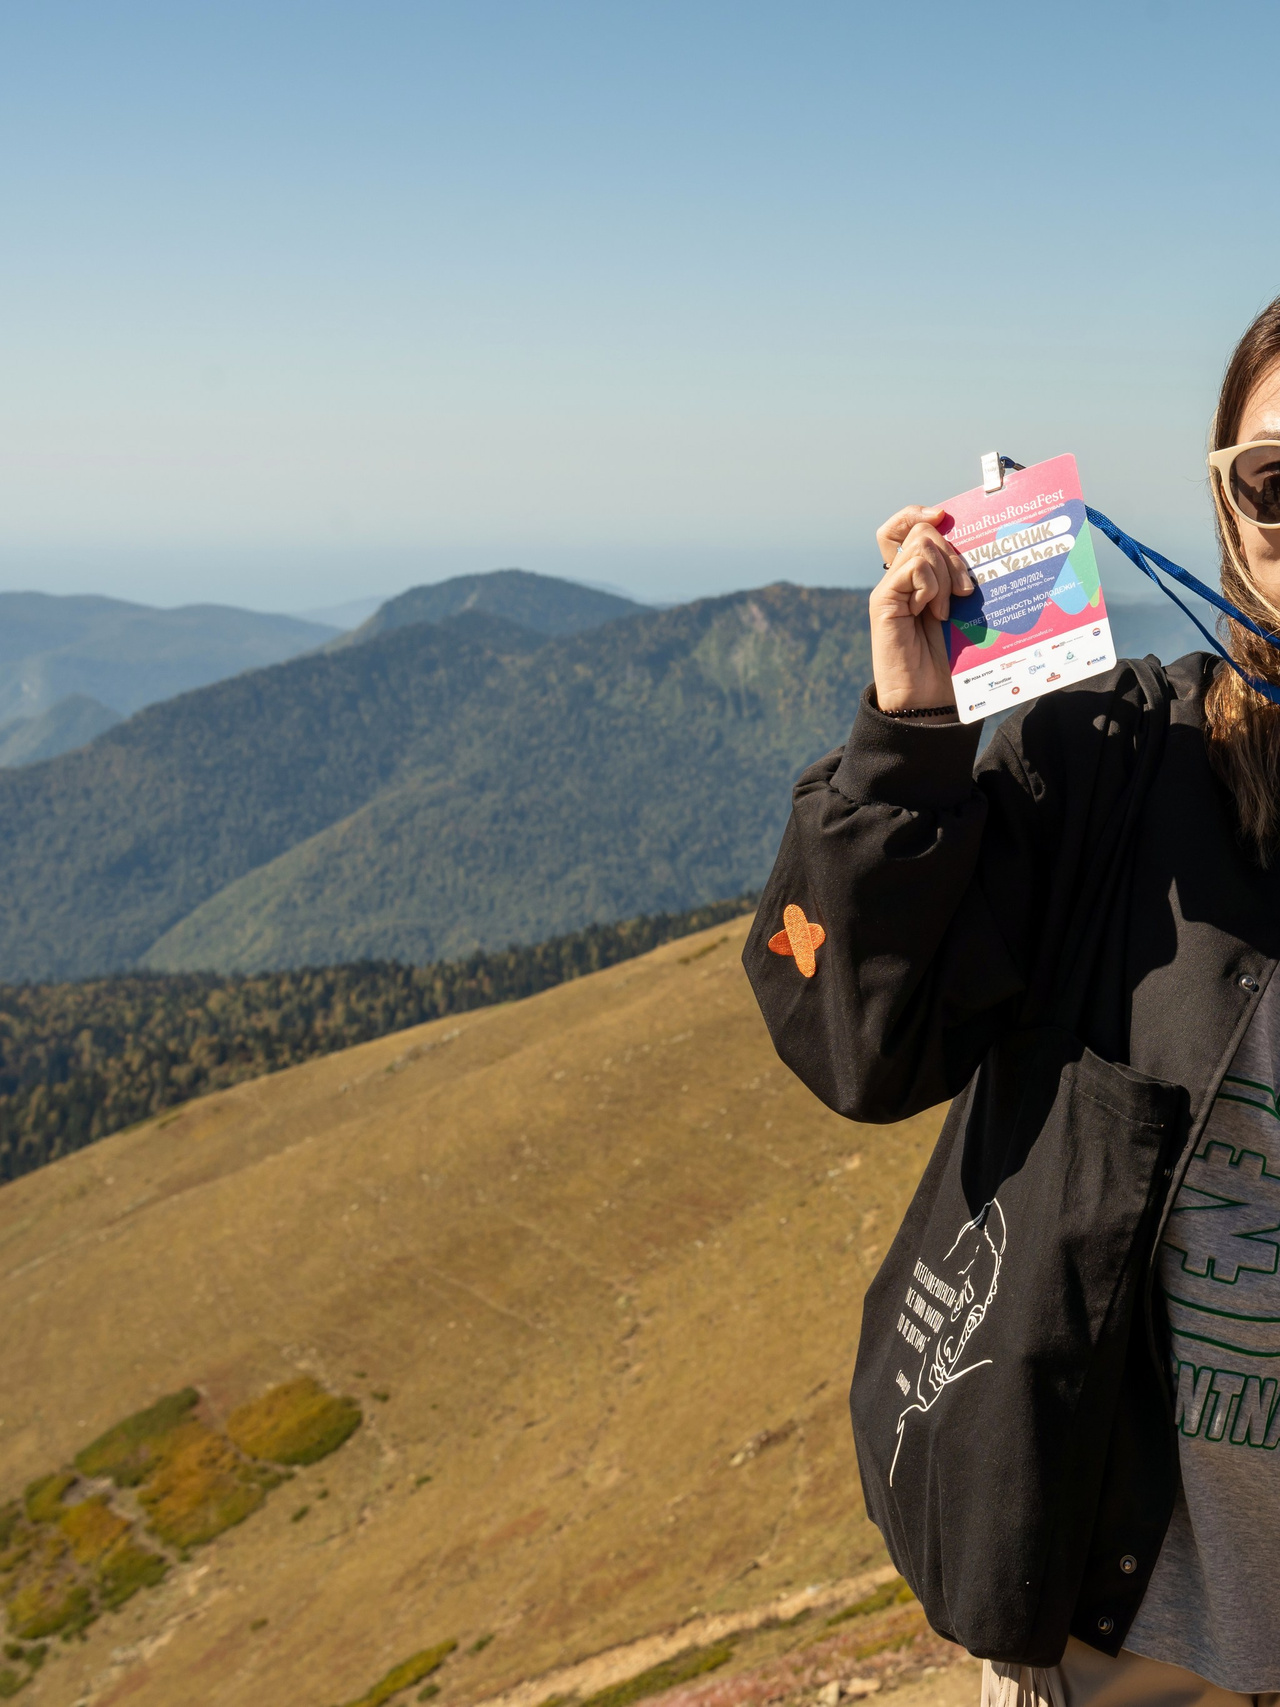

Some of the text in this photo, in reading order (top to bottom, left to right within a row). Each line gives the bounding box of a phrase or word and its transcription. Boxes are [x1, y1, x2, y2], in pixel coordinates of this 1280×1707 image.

[968, 522, 1054, 567] УЧАСТНИК
[990, 571, 1043, 598] 28/09-30/09/2024
[1033, 582, 1076, 603] МОЛОДЕЖИ
[993, 609, 1026, 627] БУДУЩЕЕ
